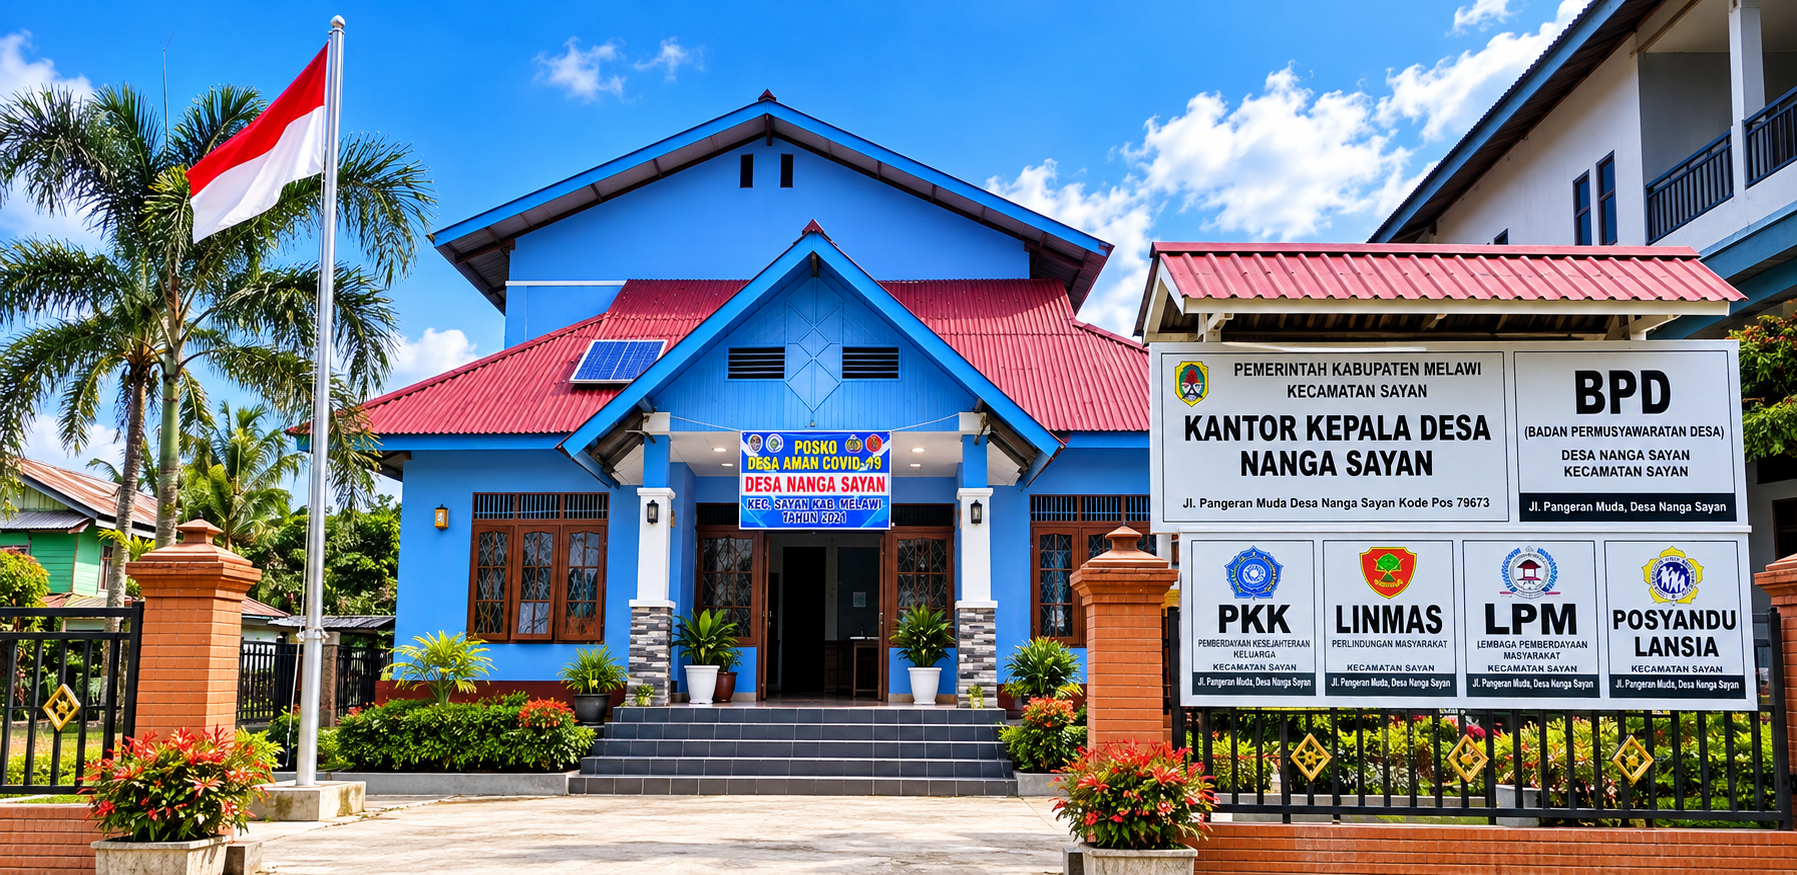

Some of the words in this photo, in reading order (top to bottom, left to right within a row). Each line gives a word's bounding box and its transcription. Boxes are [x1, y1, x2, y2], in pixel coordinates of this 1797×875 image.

[1234, 362, 1327, 377] PEMERINTAH
[1332, 362, 1420, 377] KABUPATEN
[1424, 362, 1481, 376] MELAWI
[1287, 385, 1376, 399] KECAMATAN
[1380, 384, 1427, 398] SAYAN
[1574, 370, 1671, 414] BPD
[1185, 415, 1297, 442] KANTOR
[1307, 415, 1411, 441] KEPALA
[1420, 415, 1491, 441] DESA
[1524, 426, 1568, 440] (BADAN
[1571, 426, 1687, 438] PERMUSYAWARATAN
[1690, 426, 1724, 440] DESA)
[794, 440, 837, 455] POSKO
[1561, 450, 1596, 461] DESA
[1600, 450, 1645, 461] NANGA
[1648, 450, 1690, 461] SAYAN
[748, 456, 779, 470] DESA
[783, 456, 818, 470] AMAN
[1241, 450, 1337, 477] NANGA
[1346, 450, 1433, 477] SAYAN
[1564, 466, 1642, 477] KECAMATAN
[1646, 466, 1688, 477] SAYAN
[745, 476, 782, 492] DESA
[787, 476, 836, 492] NANGA
[841, 476, 885, 492] SAYAN
[774, 498, 809, 510] SAYAN
[840, 498, 882, 509] MELAWI
[1182, 498, 1196, 509] Jl.
[1199, 498, 1253, 512] Pangeran
[1256, 498, 1286, 509] Muda
[1290, 498, 1318, 509] Desa
[1321, 498, 1358, 511] Nanga
[1360, 498, 1395, 511] Sayan
[1398, 498, 1428, 509] Kode
[1431, 498, 1453, 509] Pos
[1457, 497, 1490, 508] 79673
[1528, 501, 1541, 512] Jl.
[1544, 501, 1593, 515] Pangeran
[1596, 501, 1627, 514] Muda,
[1630, 501, 1656, 512] Desa
[1659, 501, 1692, 515] Nanga
[1695, 501, 1726, 515] Sayan
[782, 511, 818, 523] TAHUN
[1218, 604, 1291, 634] PKK
[1336, 604, 1443, 634] LINMAS
[1484, 603, 1577, 635] LPM
[1613, 609, 1736, 630] POSYANDU
[1198, 639, 1251, 648] PEMBERDAYAAN
[1252, 639, 1310, 648] KESEJAHTERAAN
[1332, 640, 1393, 648] PERLINDUNGAN
[1395, 640, 1448, 648] MASYARAKAT
[1477, 641, 1517, 649] LEMBAGA
[1519, 641, 1588, 649] PEMBERDAYAAN
[1634, 636, 1719, 657] LANSIA
[1233, 650, 1276, 658] KELUARGA
[1503, 652, 1560, 660] MASYARAKAT
[1212, 663, 1266, 671] KECAMATAN
[1268, 663, 1297, 671] SAYAN
[1347, 664, 1403, 672] KECAMATAN
[1405, 664, 1435, 672] SAYAN
[1547, 665, 1577, 673] SAYAN
[1631, 665, 1690, 673] KECAMATAN
[1692, 665, 1723, 673] SAYAN
